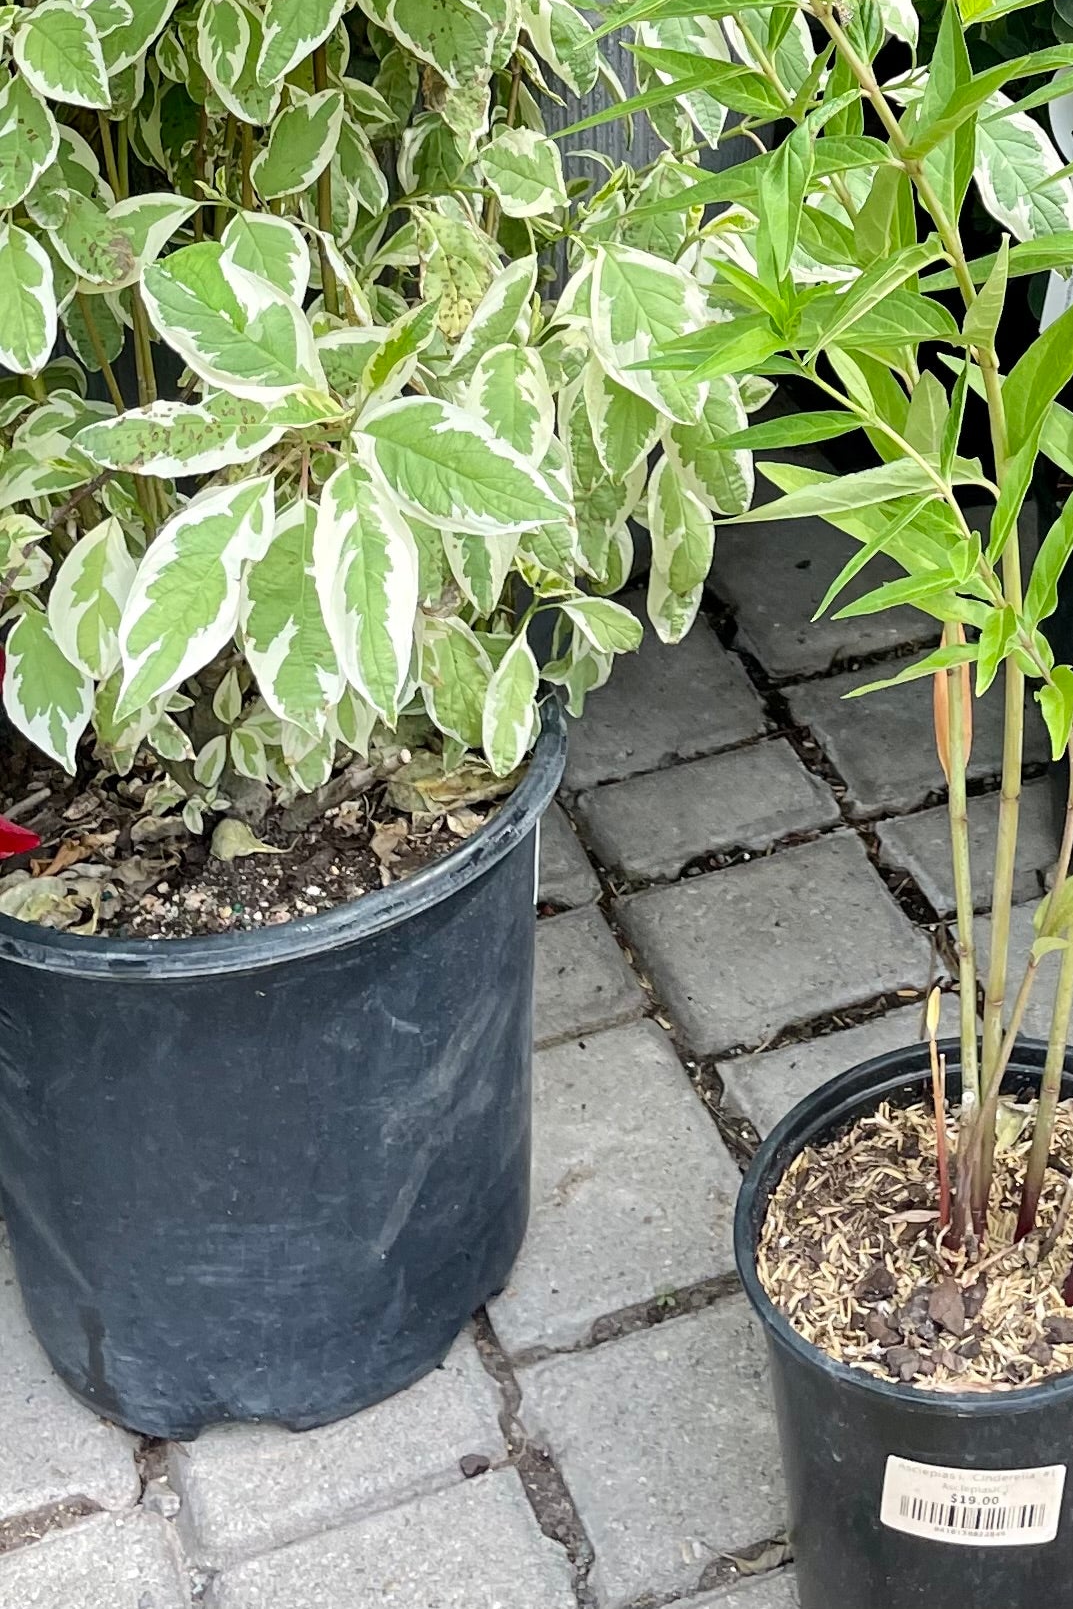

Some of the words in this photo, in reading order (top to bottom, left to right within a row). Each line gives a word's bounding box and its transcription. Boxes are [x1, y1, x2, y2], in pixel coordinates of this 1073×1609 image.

[898, 1463, 955, 1481] Asclepias
[972, 1472, 1035, 1482] Cinderella
[950, 1493, 1000, 1505] $19.00
